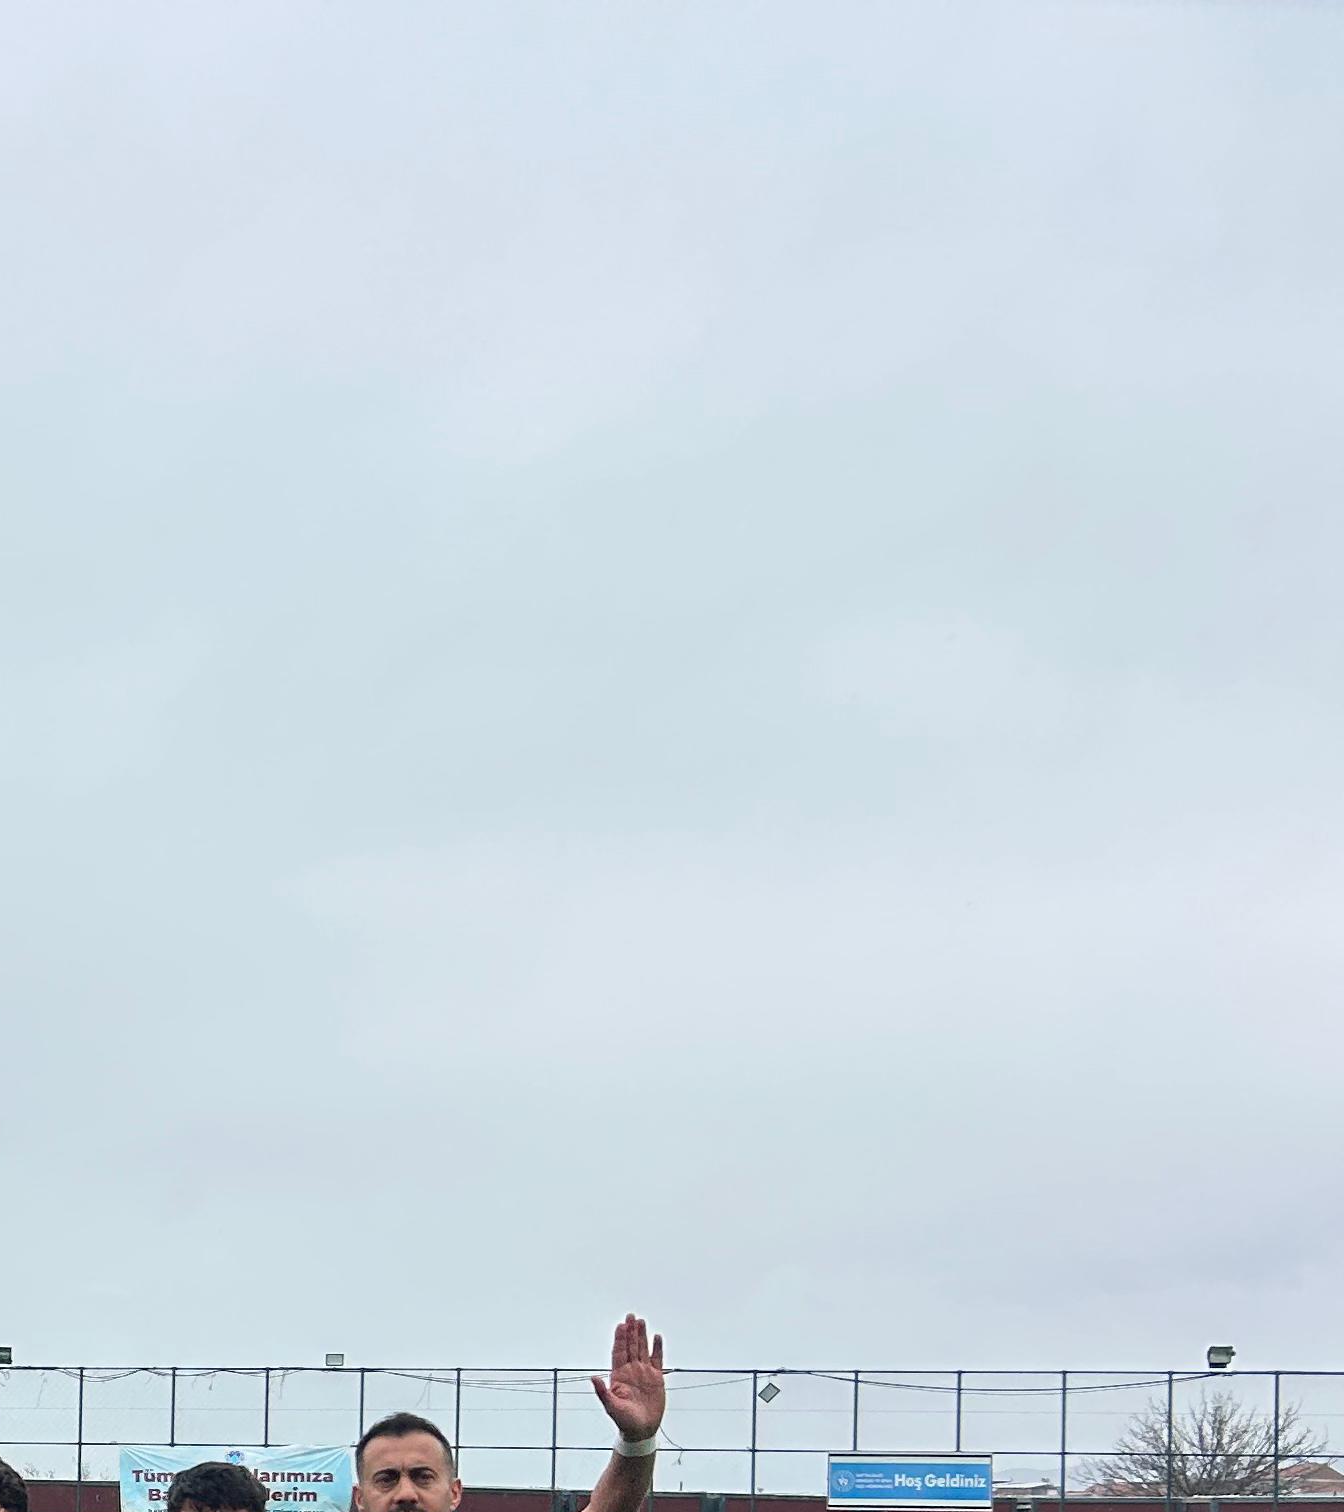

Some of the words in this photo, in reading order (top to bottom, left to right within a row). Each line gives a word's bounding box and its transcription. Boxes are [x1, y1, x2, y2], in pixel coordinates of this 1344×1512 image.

[132, 1468, 175, 1483] Tüm
[894, 1473, 922, 1491] Hoş
[924, 1472, 987, 1489] Geldiniz
